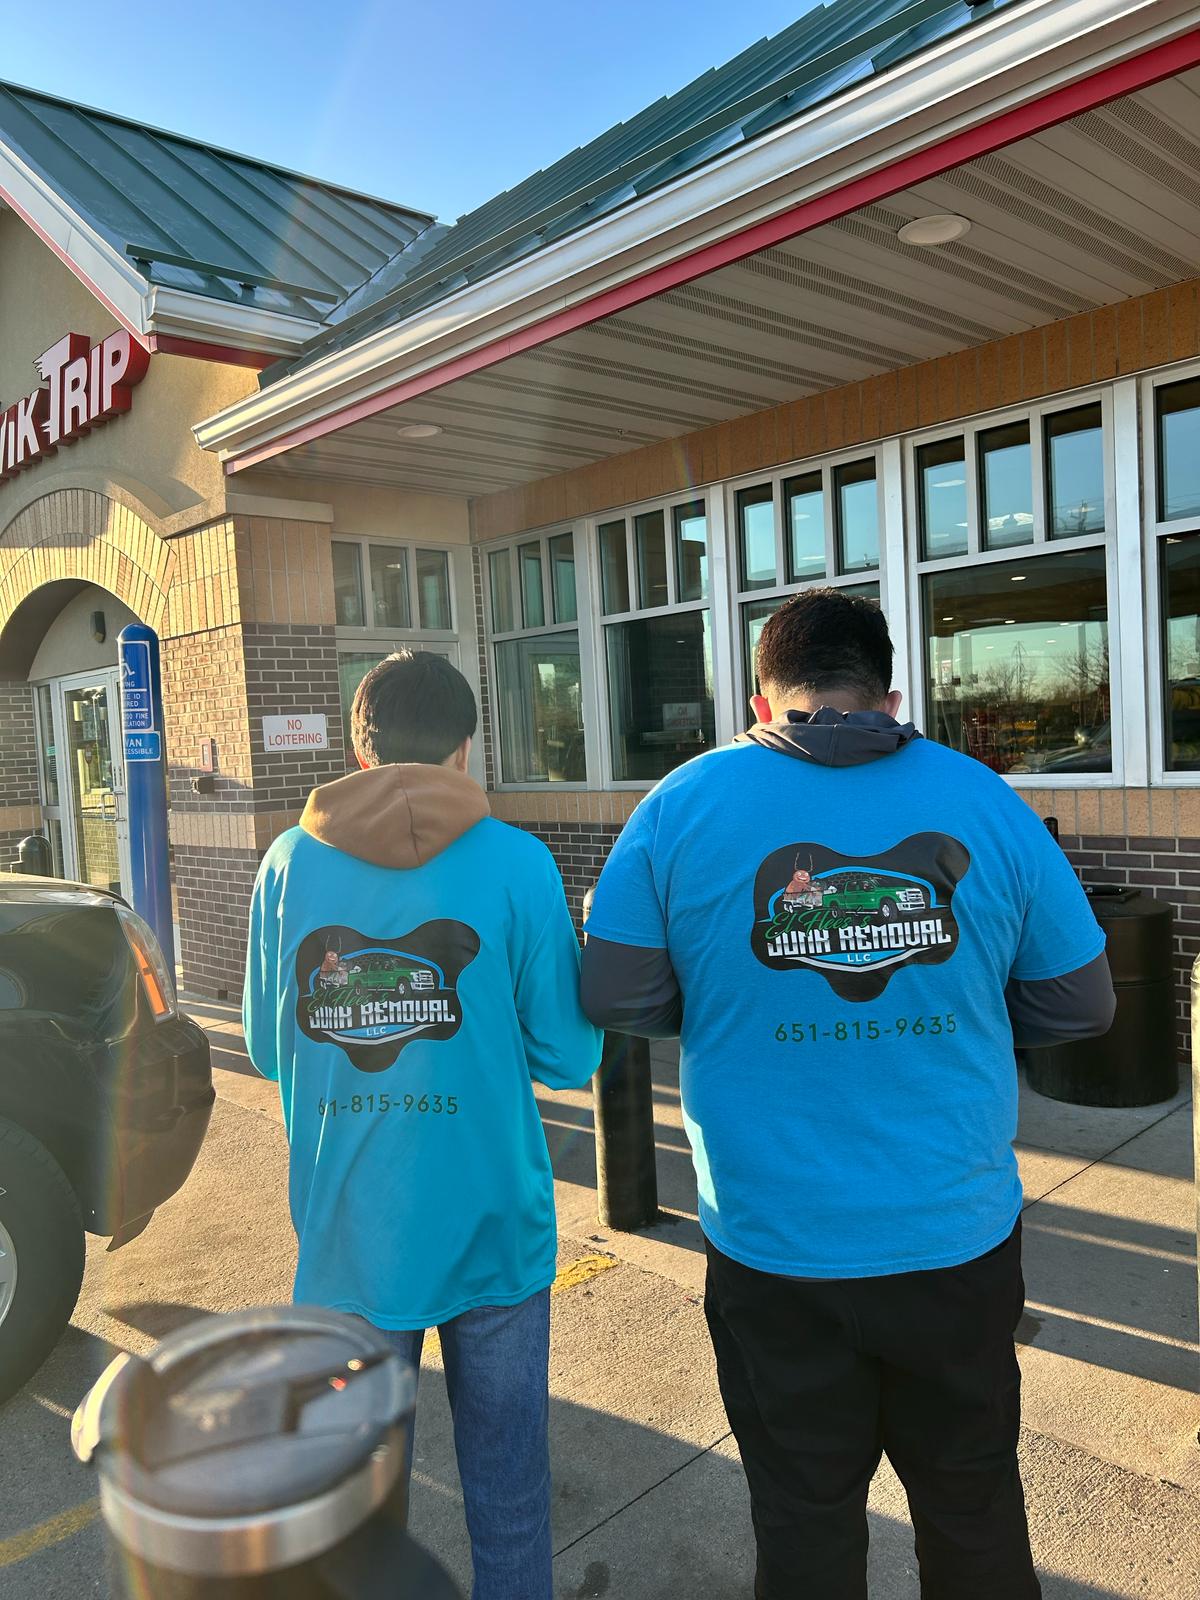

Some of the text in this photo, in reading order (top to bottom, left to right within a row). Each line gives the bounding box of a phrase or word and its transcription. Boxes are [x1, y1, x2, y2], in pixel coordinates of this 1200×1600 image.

[33, 328, 133, 446] TRIP
[135, 712, 149, 720] FINE
[287, 719, 303, 731] NO
[268, 732, 323, 746] LOITERING
[767, 918, 952, 957] JUNK REMOVAL
[847, 953, 871, 962] LLC
[309, 999, 456, 1029] JUNK REMOVAL
[366, 1026, 386, 1036] LLC
[774, 1013, 957, 1042] 651-815-9635
